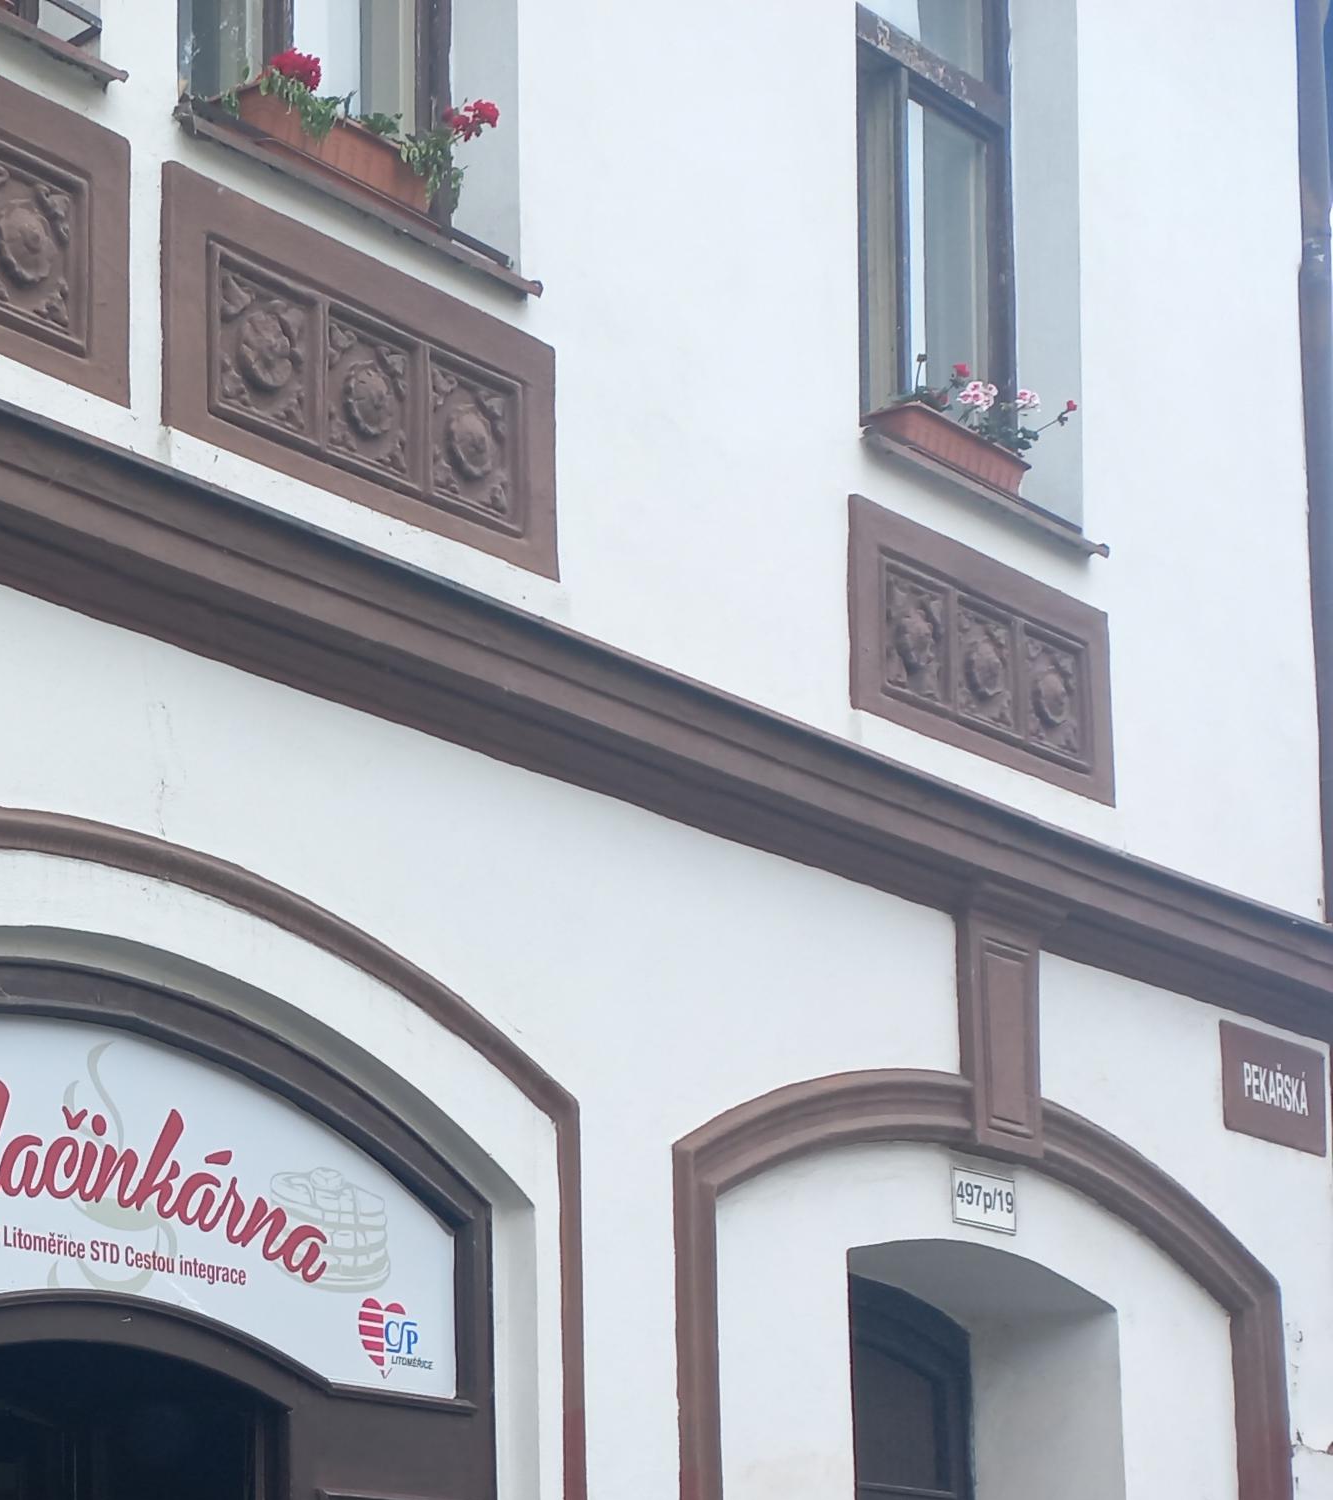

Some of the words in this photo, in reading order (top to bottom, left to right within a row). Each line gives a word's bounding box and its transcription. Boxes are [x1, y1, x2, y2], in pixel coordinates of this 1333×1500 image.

[1243, 1062, 1309, 1116] PEKAŘSKÁ
[956, 1181, 1014, 1214] 497p/19
[3, 1225, 85, 1259] Litoměřice
[90, 1240, 120, 1264] STD
[125, 1246, 175, 1274] Cestou
[179, 1255, 247, 1285] integrace
